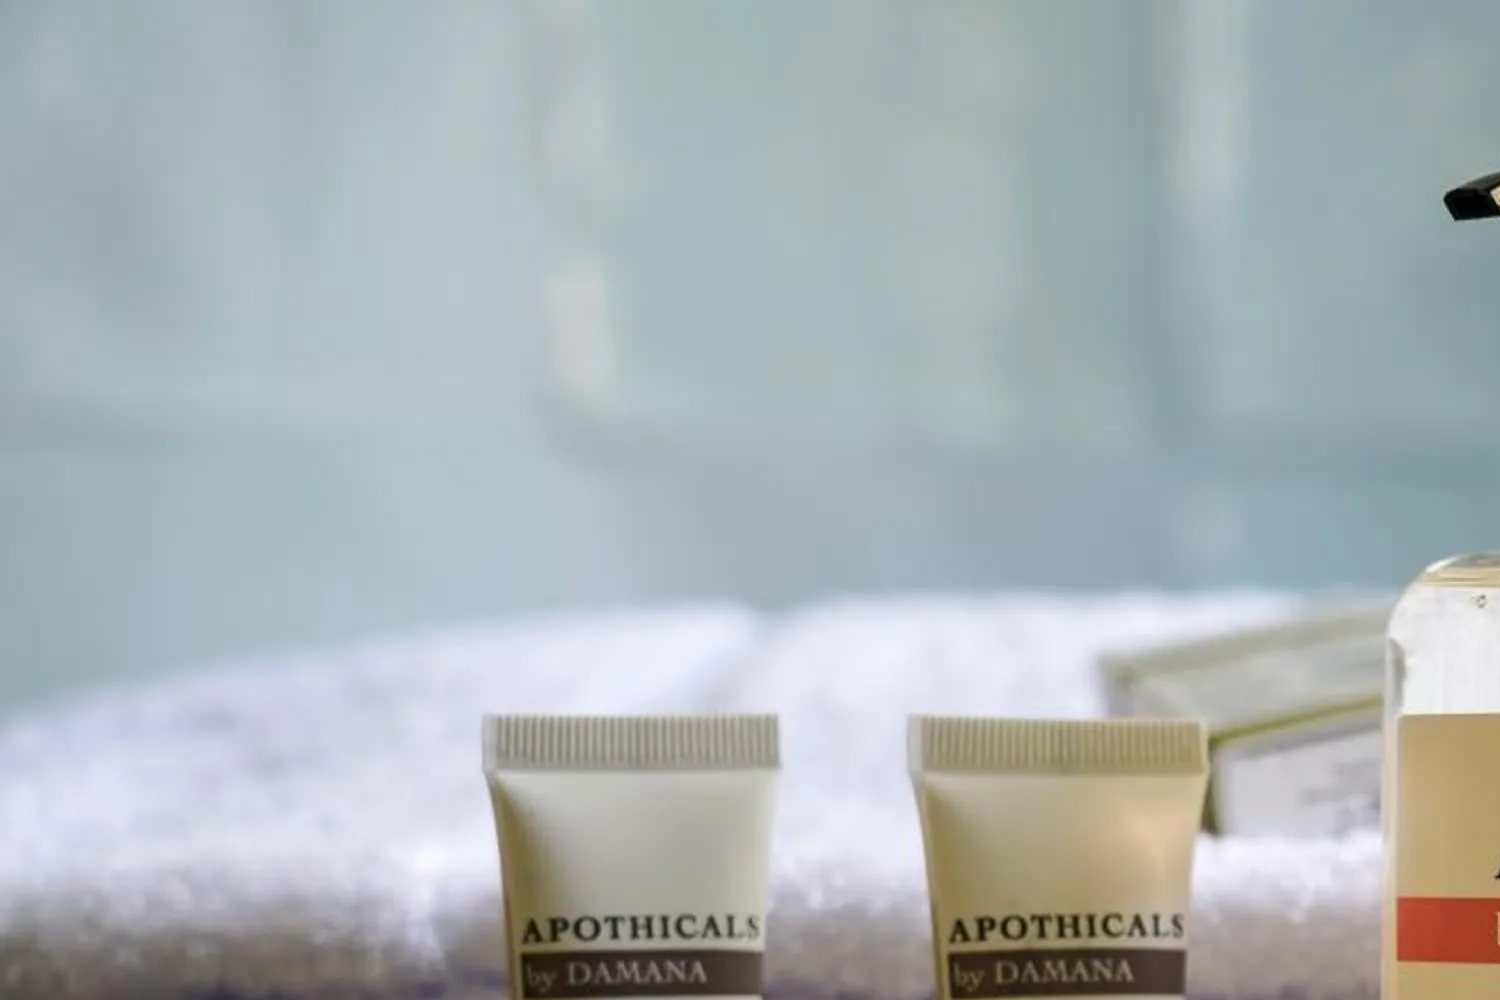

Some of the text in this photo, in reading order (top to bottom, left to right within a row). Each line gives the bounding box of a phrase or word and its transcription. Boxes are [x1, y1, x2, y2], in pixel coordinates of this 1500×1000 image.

[522, 914, 760, 944] APOTHICALS
[949, 913, 1184, 945] APOTHICALS
[526, 959, 708, 992] by DAMANA
[954, 958, 1135, 991] by DAMANA
